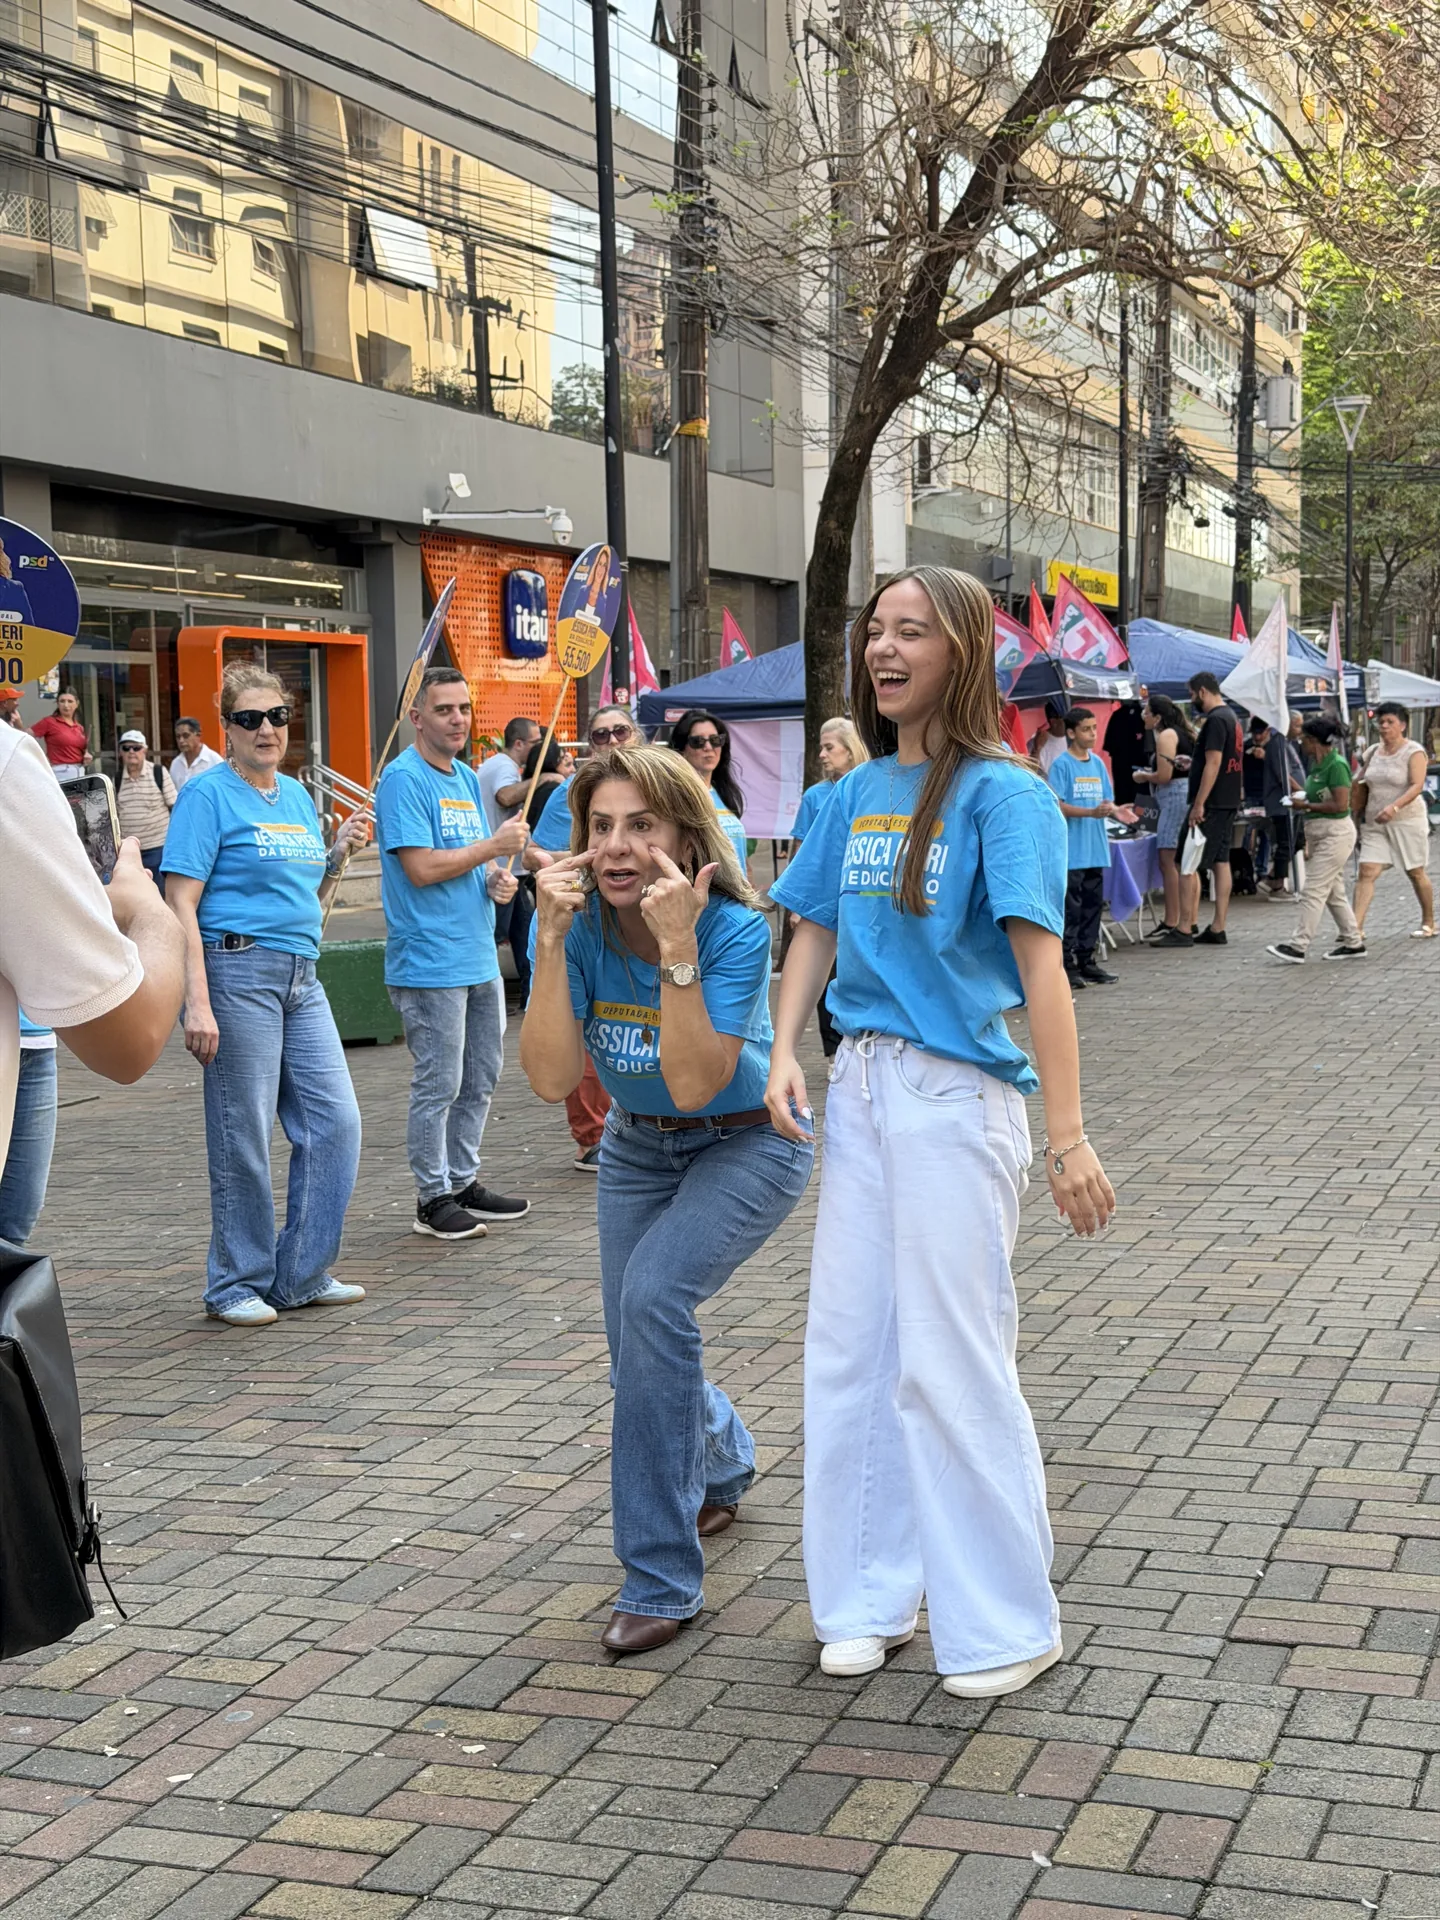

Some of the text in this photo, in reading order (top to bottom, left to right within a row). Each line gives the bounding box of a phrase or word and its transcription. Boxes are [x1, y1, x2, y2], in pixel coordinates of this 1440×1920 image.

[19, 555, 48, 568] psd
[516, 604, 548, 641] itaú
[259, 847, 276, 857] DA
